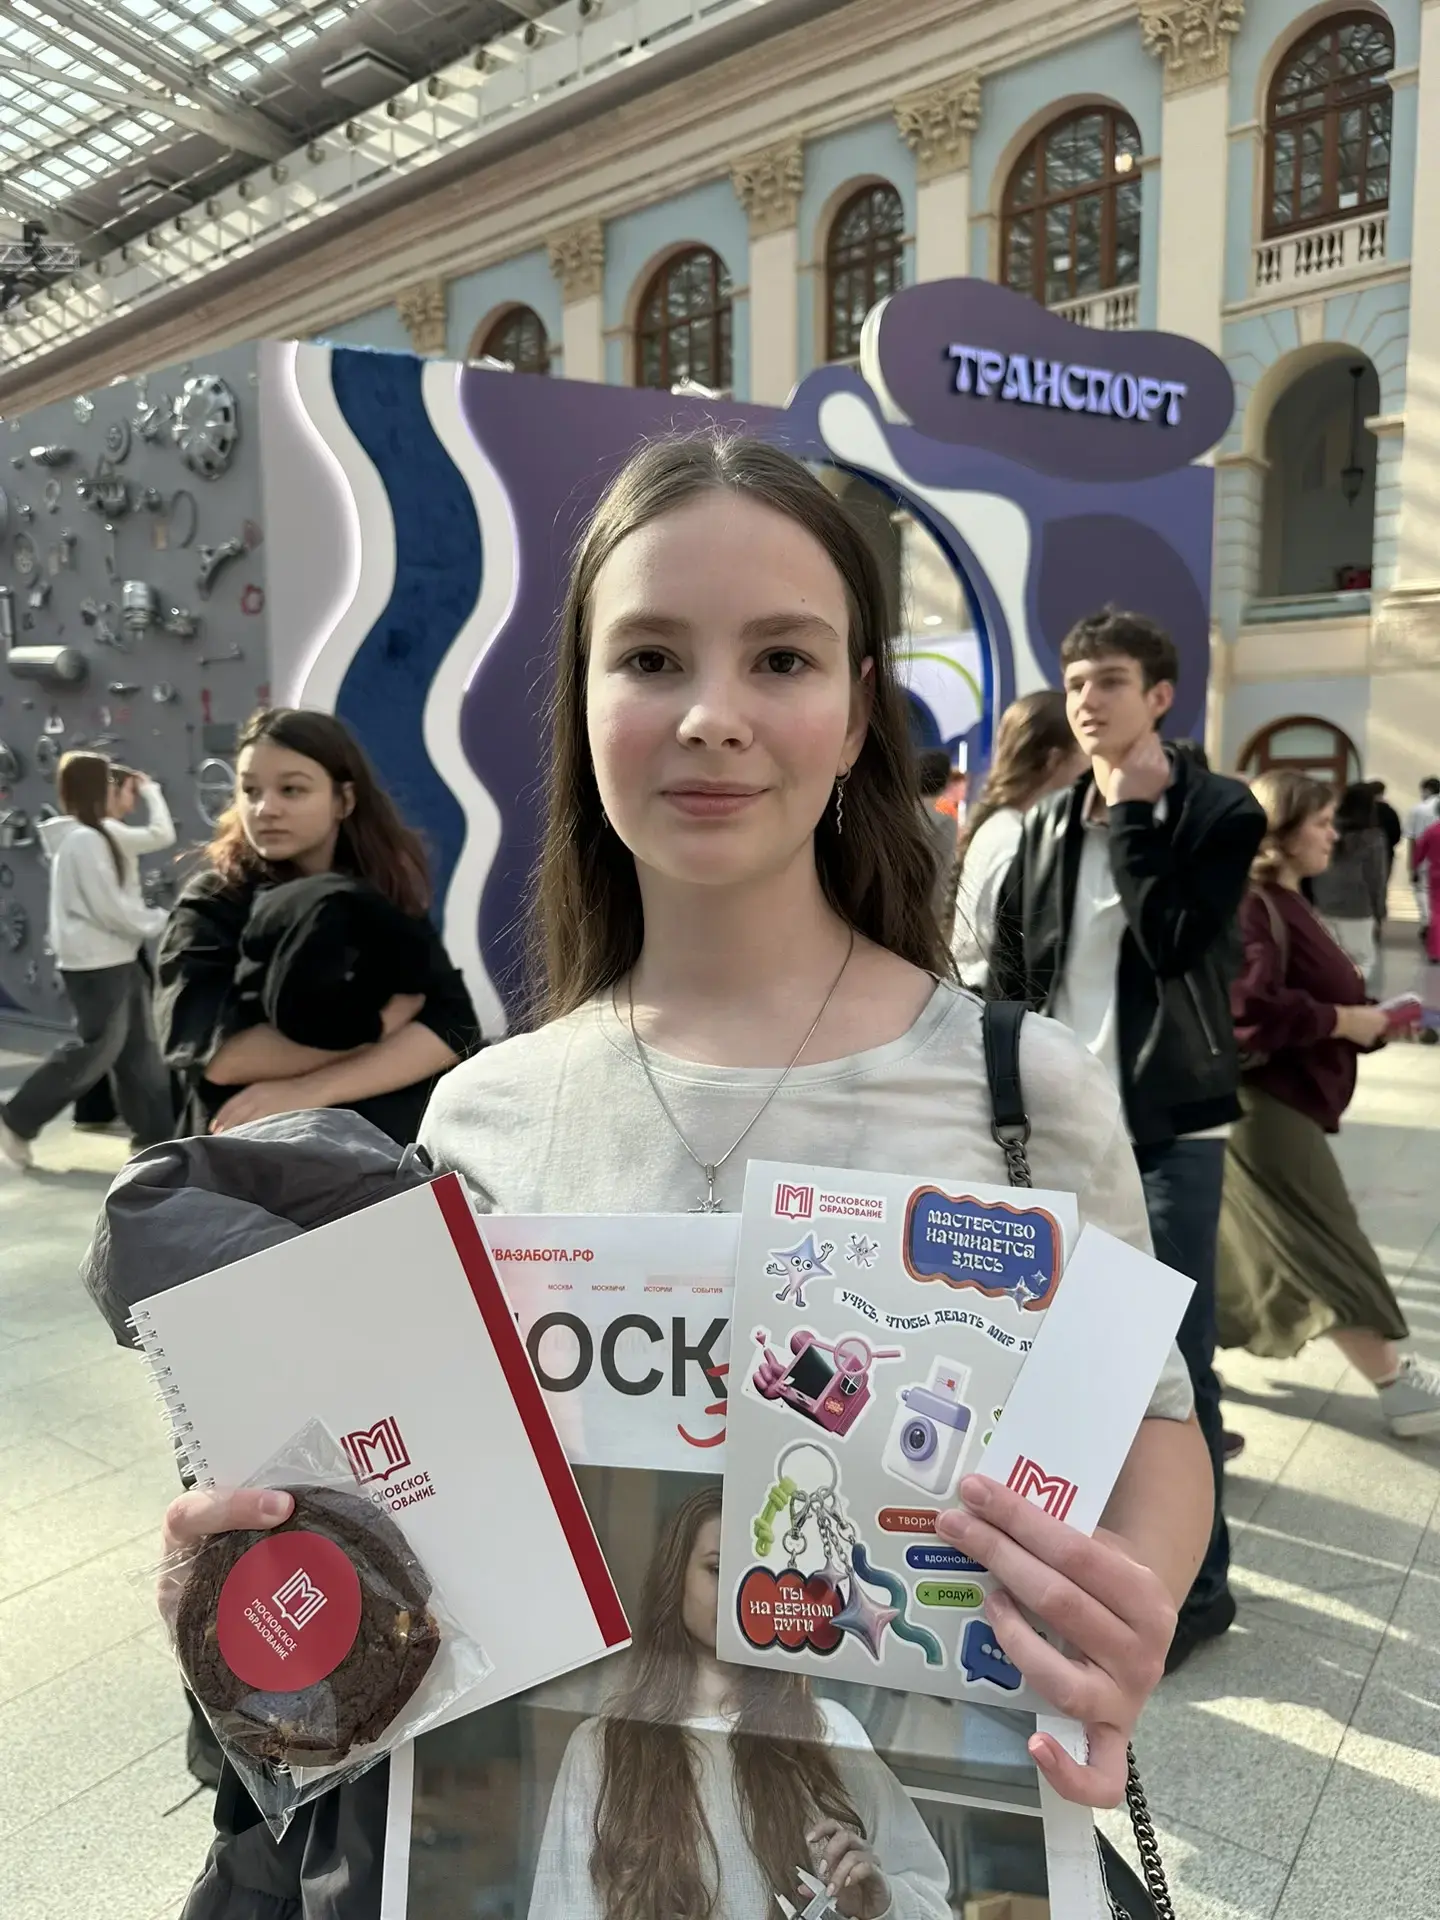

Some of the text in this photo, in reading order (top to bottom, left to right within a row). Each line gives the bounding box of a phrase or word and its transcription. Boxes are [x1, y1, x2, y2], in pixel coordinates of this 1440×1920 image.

[948, 343, 1188, 426] ТРАНСПОРТ
[818, 1204, 882, 1219] ОБРАЗОВАНИЕ
[819, 1194, 883, 1209] МОСКОВСКОЕ
[927, 1209, 1036, 1240] МАСТЕРСТВО
[926, 1227, 1036, 1259] НАЧИНАЕТСЯ
[952, 1250, 1004, 1273] ЗДЕСЬ
[841, 1291, 879, 1323] УЧУСЬ,
[885, 1314, 931, 1330] ЧТОБЫ
[935, 1310, 985, 1329] ДЕЛАТЬ
[987, 1325, 1015, 1347] МИР
[514, 1311, 730, 1398] ОСК
[780, 1586, 804, 1600] ТЫ
[938, 1589, 974, 1602] радуй
[750, 1600, 834, 1617] НА ВЕРНОМ
[243, 1607, 290, 1661] ОБРАЗОВАНИЕ
[252, 1598, 298, 1652] МОСКОВСКОЕ
[773, 1617, 814, 1632] ПУТИ
